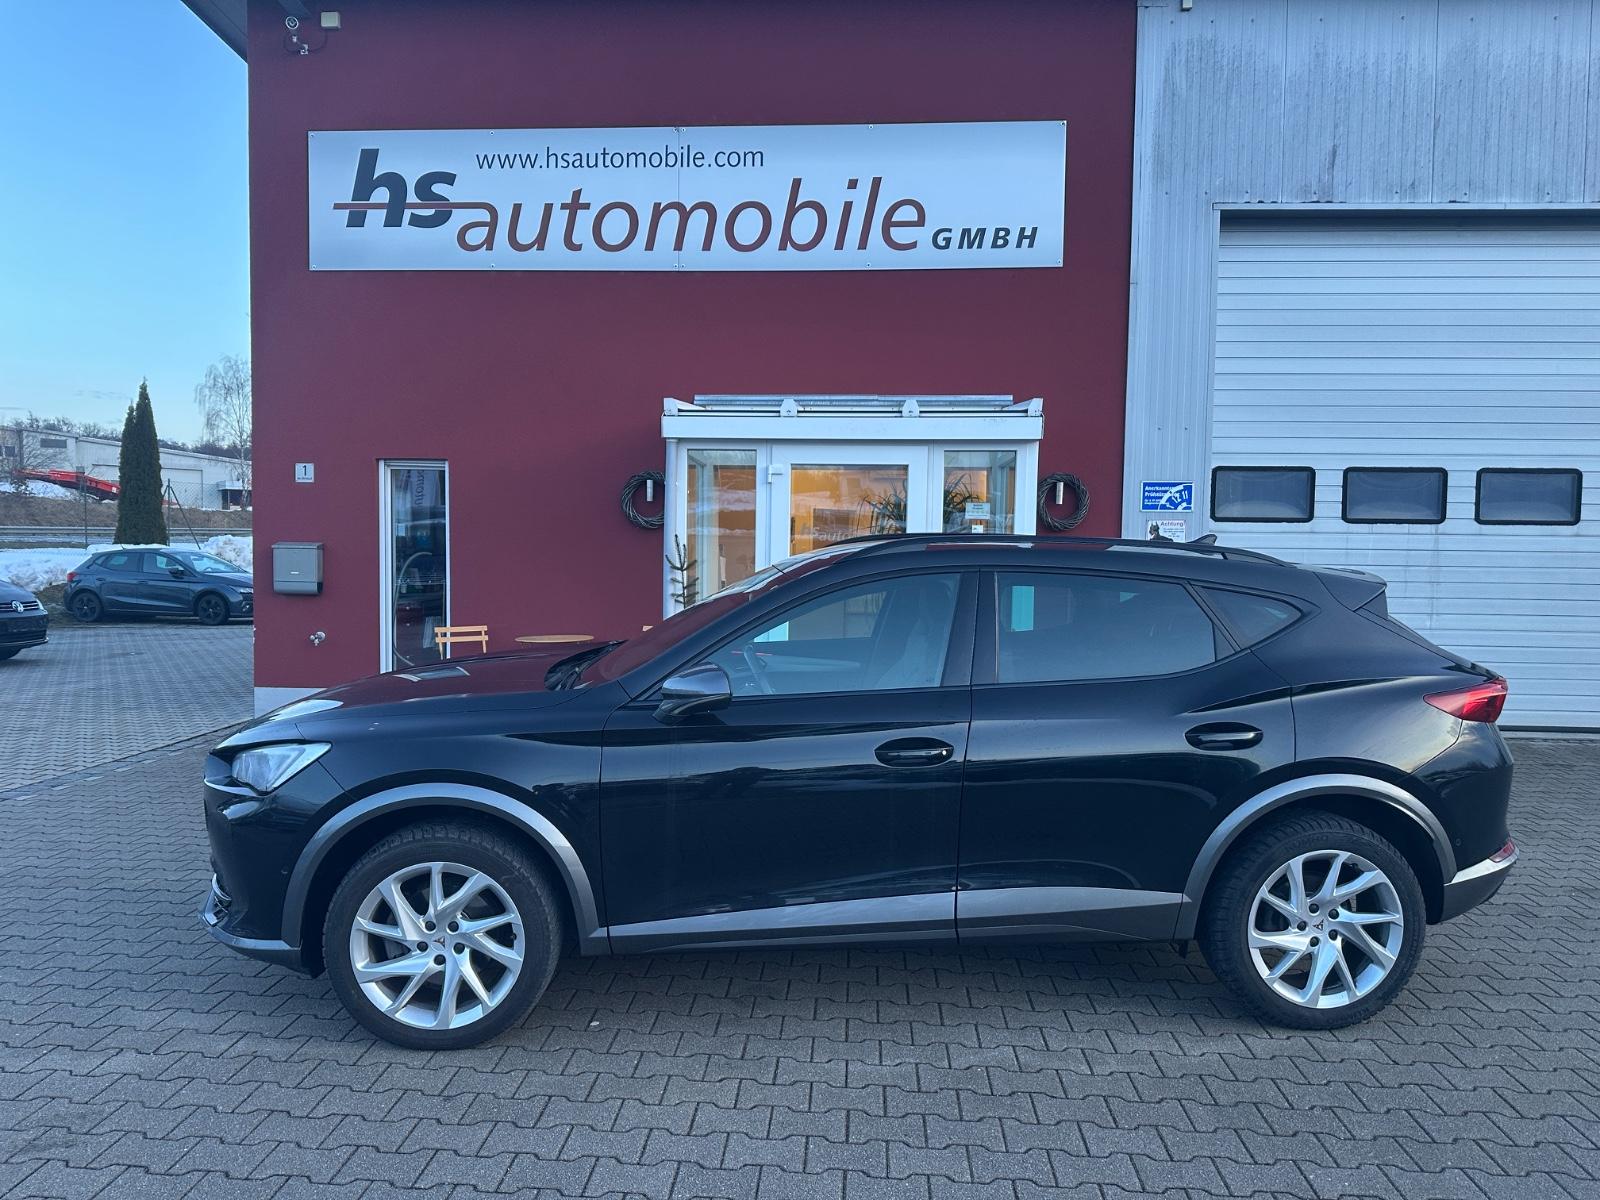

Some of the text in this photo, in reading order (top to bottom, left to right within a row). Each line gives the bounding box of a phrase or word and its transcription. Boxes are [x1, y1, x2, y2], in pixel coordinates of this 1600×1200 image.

[476, 145, 764, 169] www.hsautomobile.com
[931, 226, 1038, 251] GMBH
[302, 464, 307, 476] 1
